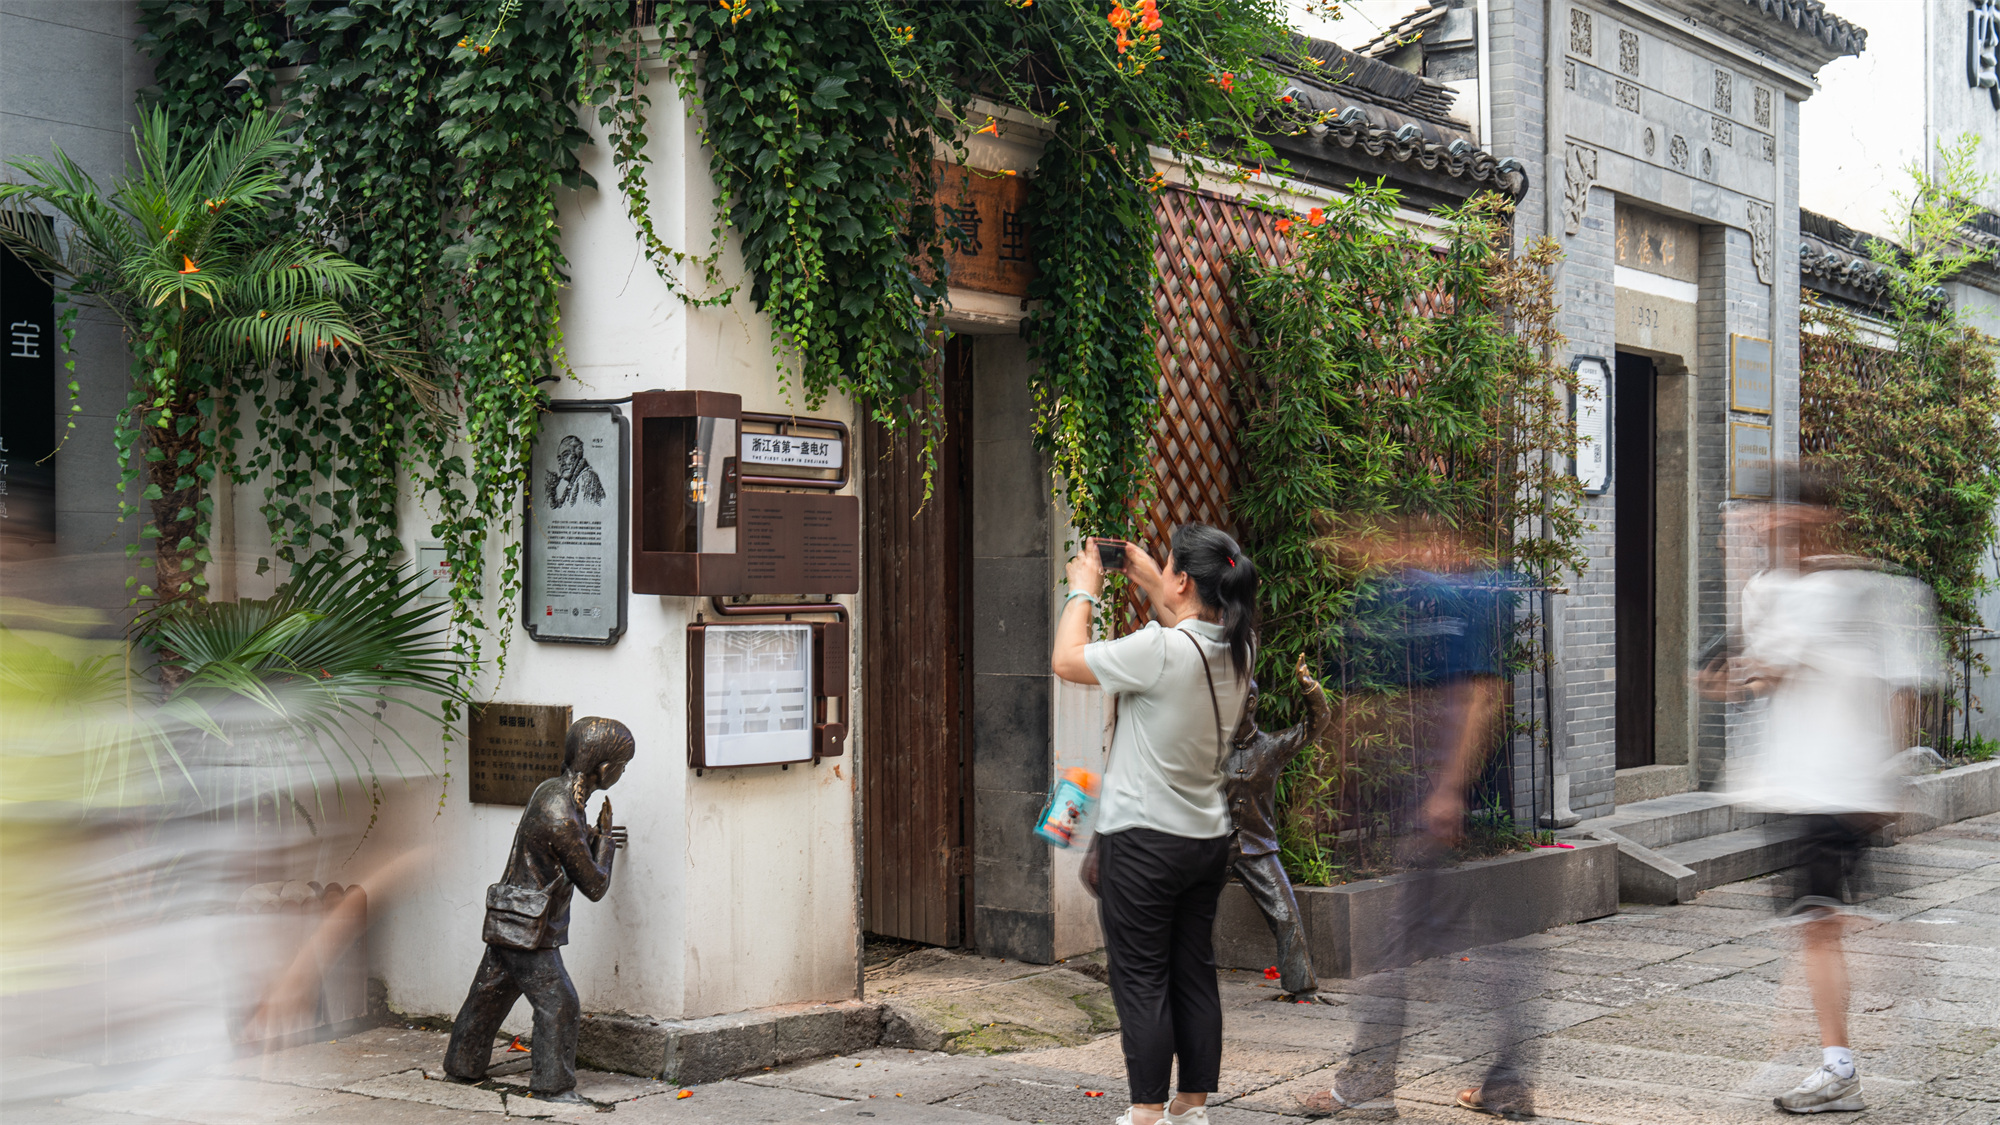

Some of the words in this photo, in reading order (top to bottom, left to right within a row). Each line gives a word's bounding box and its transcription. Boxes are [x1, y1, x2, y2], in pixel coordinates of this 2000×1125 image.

[1631, 305, 1658, 328] 1932
[11, 320, 41, 359] 宝
[752, 438, 829, 457] 浙江省第一盏电灯
